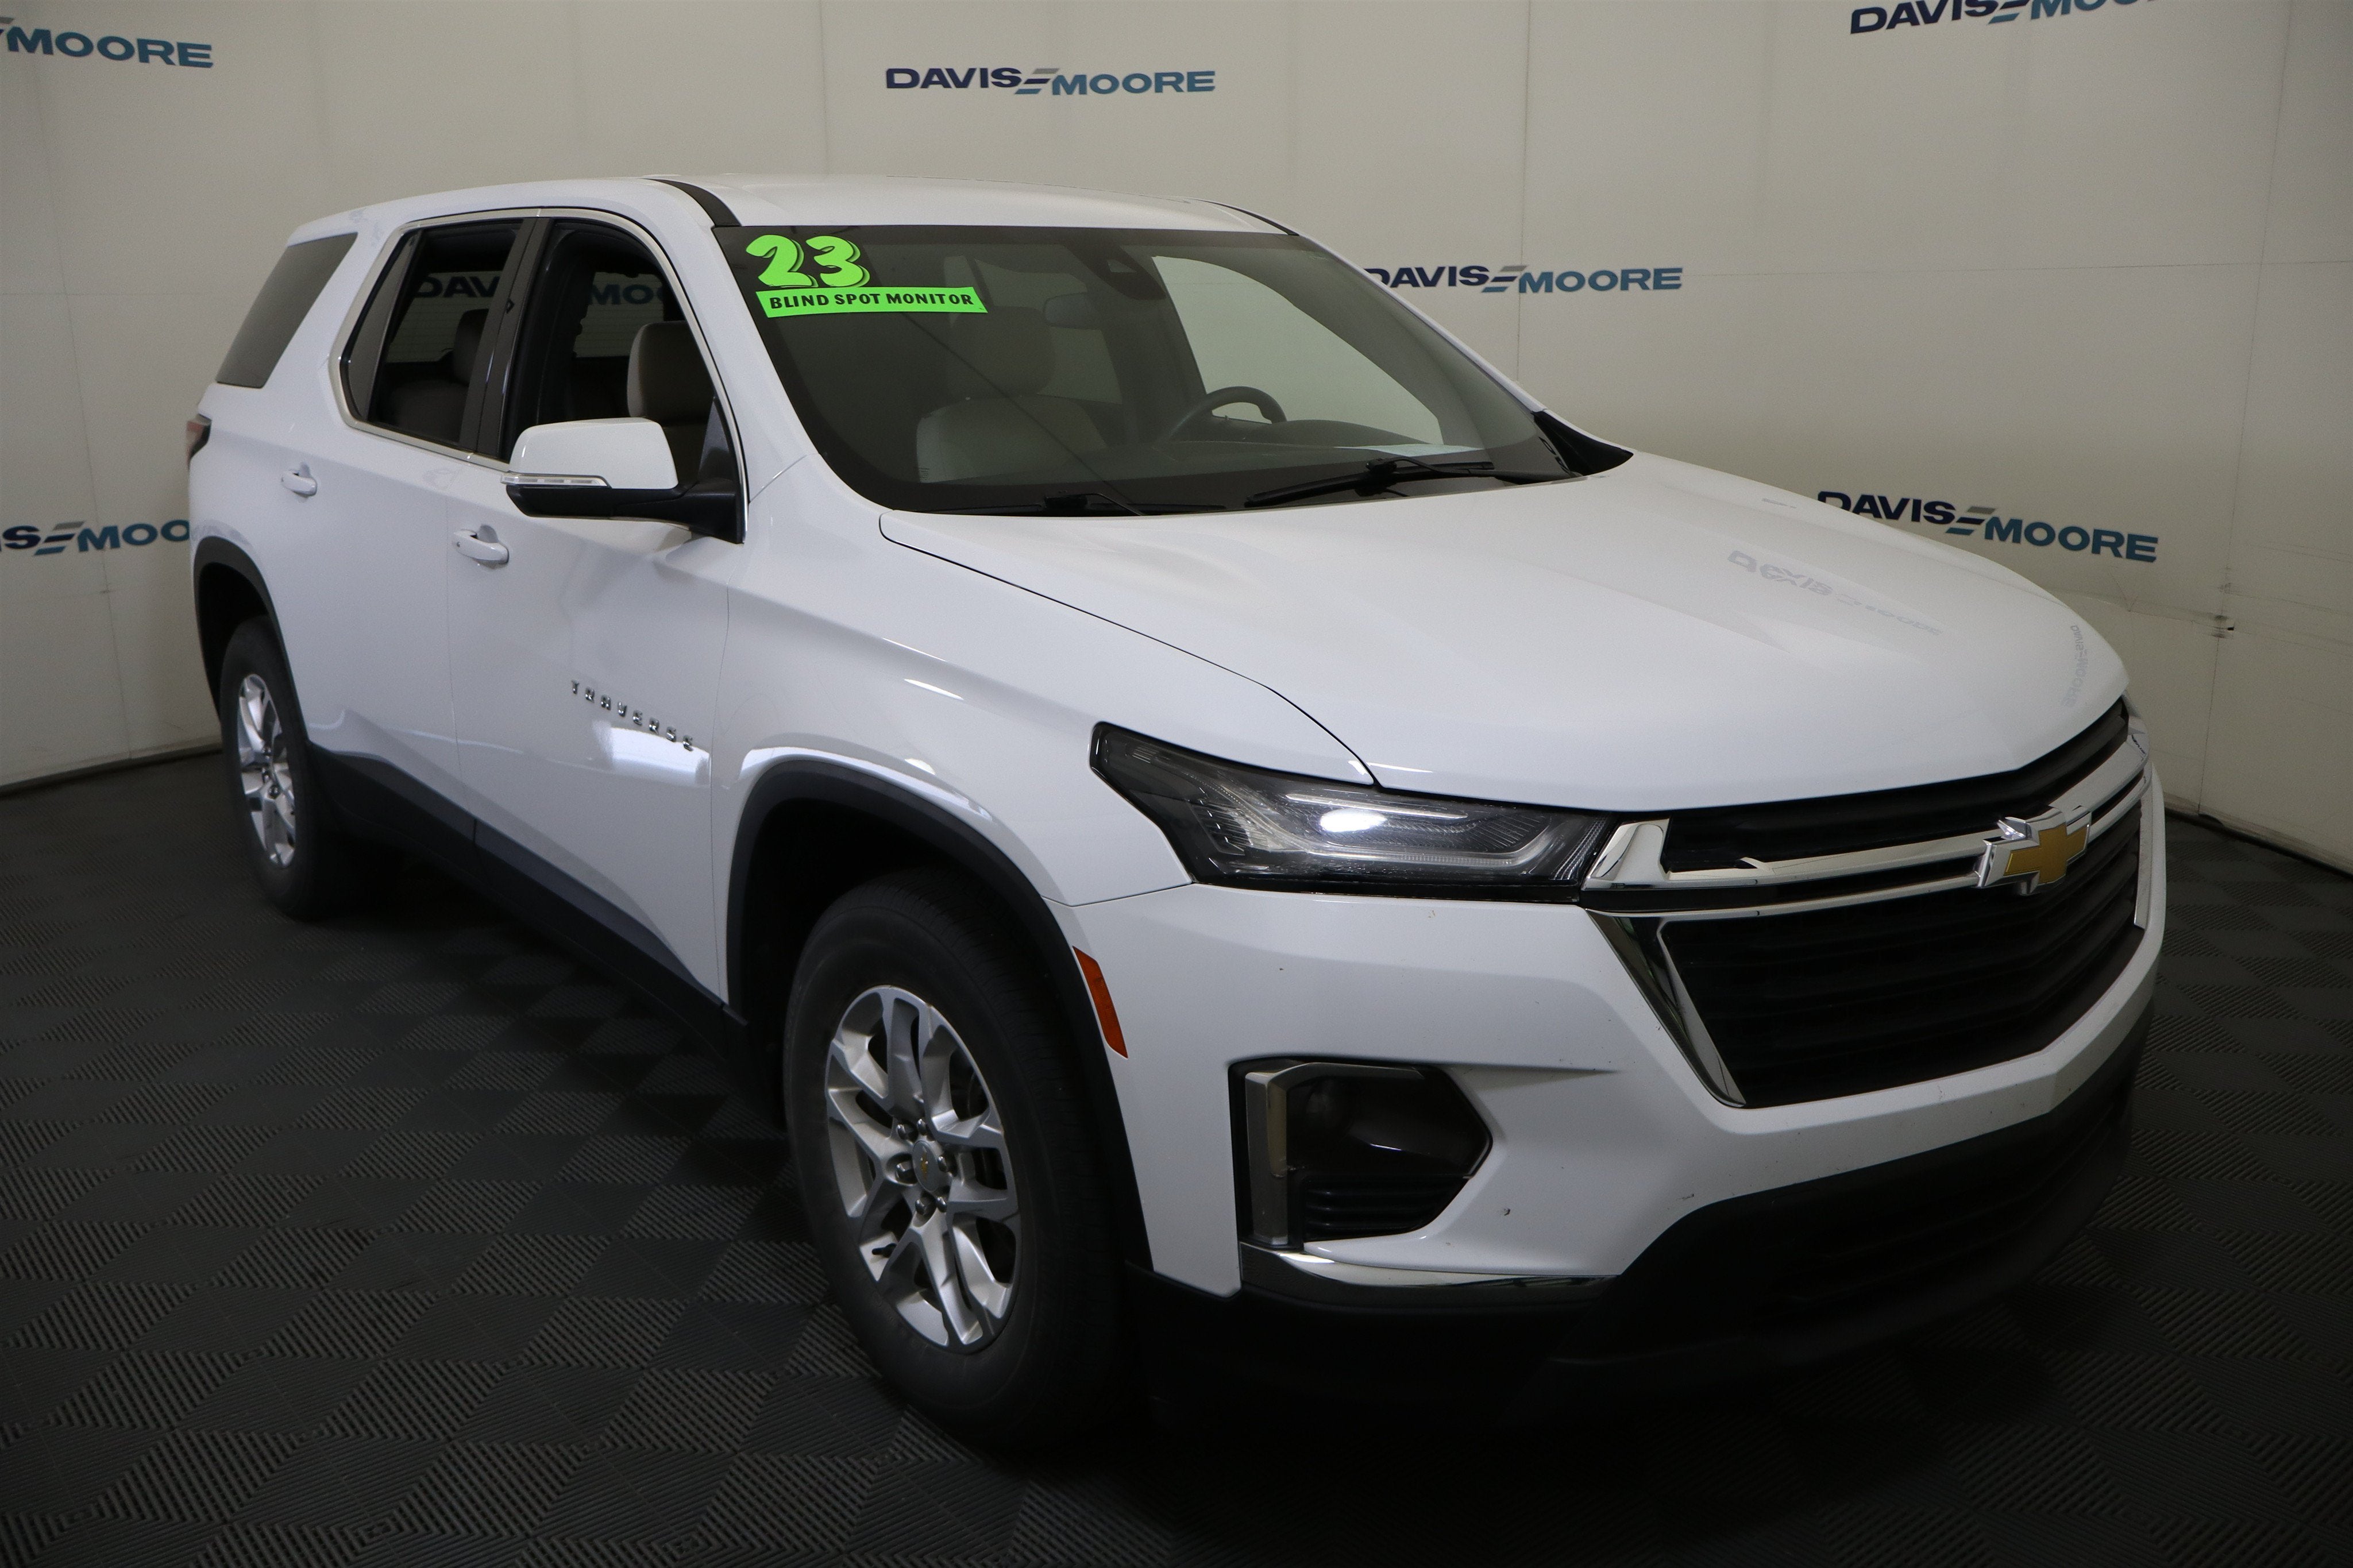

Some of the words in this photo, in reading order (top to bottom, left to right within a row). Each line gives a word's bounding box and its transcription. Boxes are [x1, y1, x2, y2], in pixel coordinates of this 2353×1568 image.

[7, 26, 213, 68] MOORE
[885, 67, 1023, 89] DAVIS
[1052, 71, 1216, 95] MOORE
[746, 234, 870, 288] 23
[1518, 268, 1683, 293] MOORE
[770, 293, 830, 309] BLIND
[834, 293, 880, 305] SPOT
[886, 293, 974, 305] MONITOR
[1985, 516, 2159, 563] MOORE
[572, 679, 693, 751] TRAVERSE
